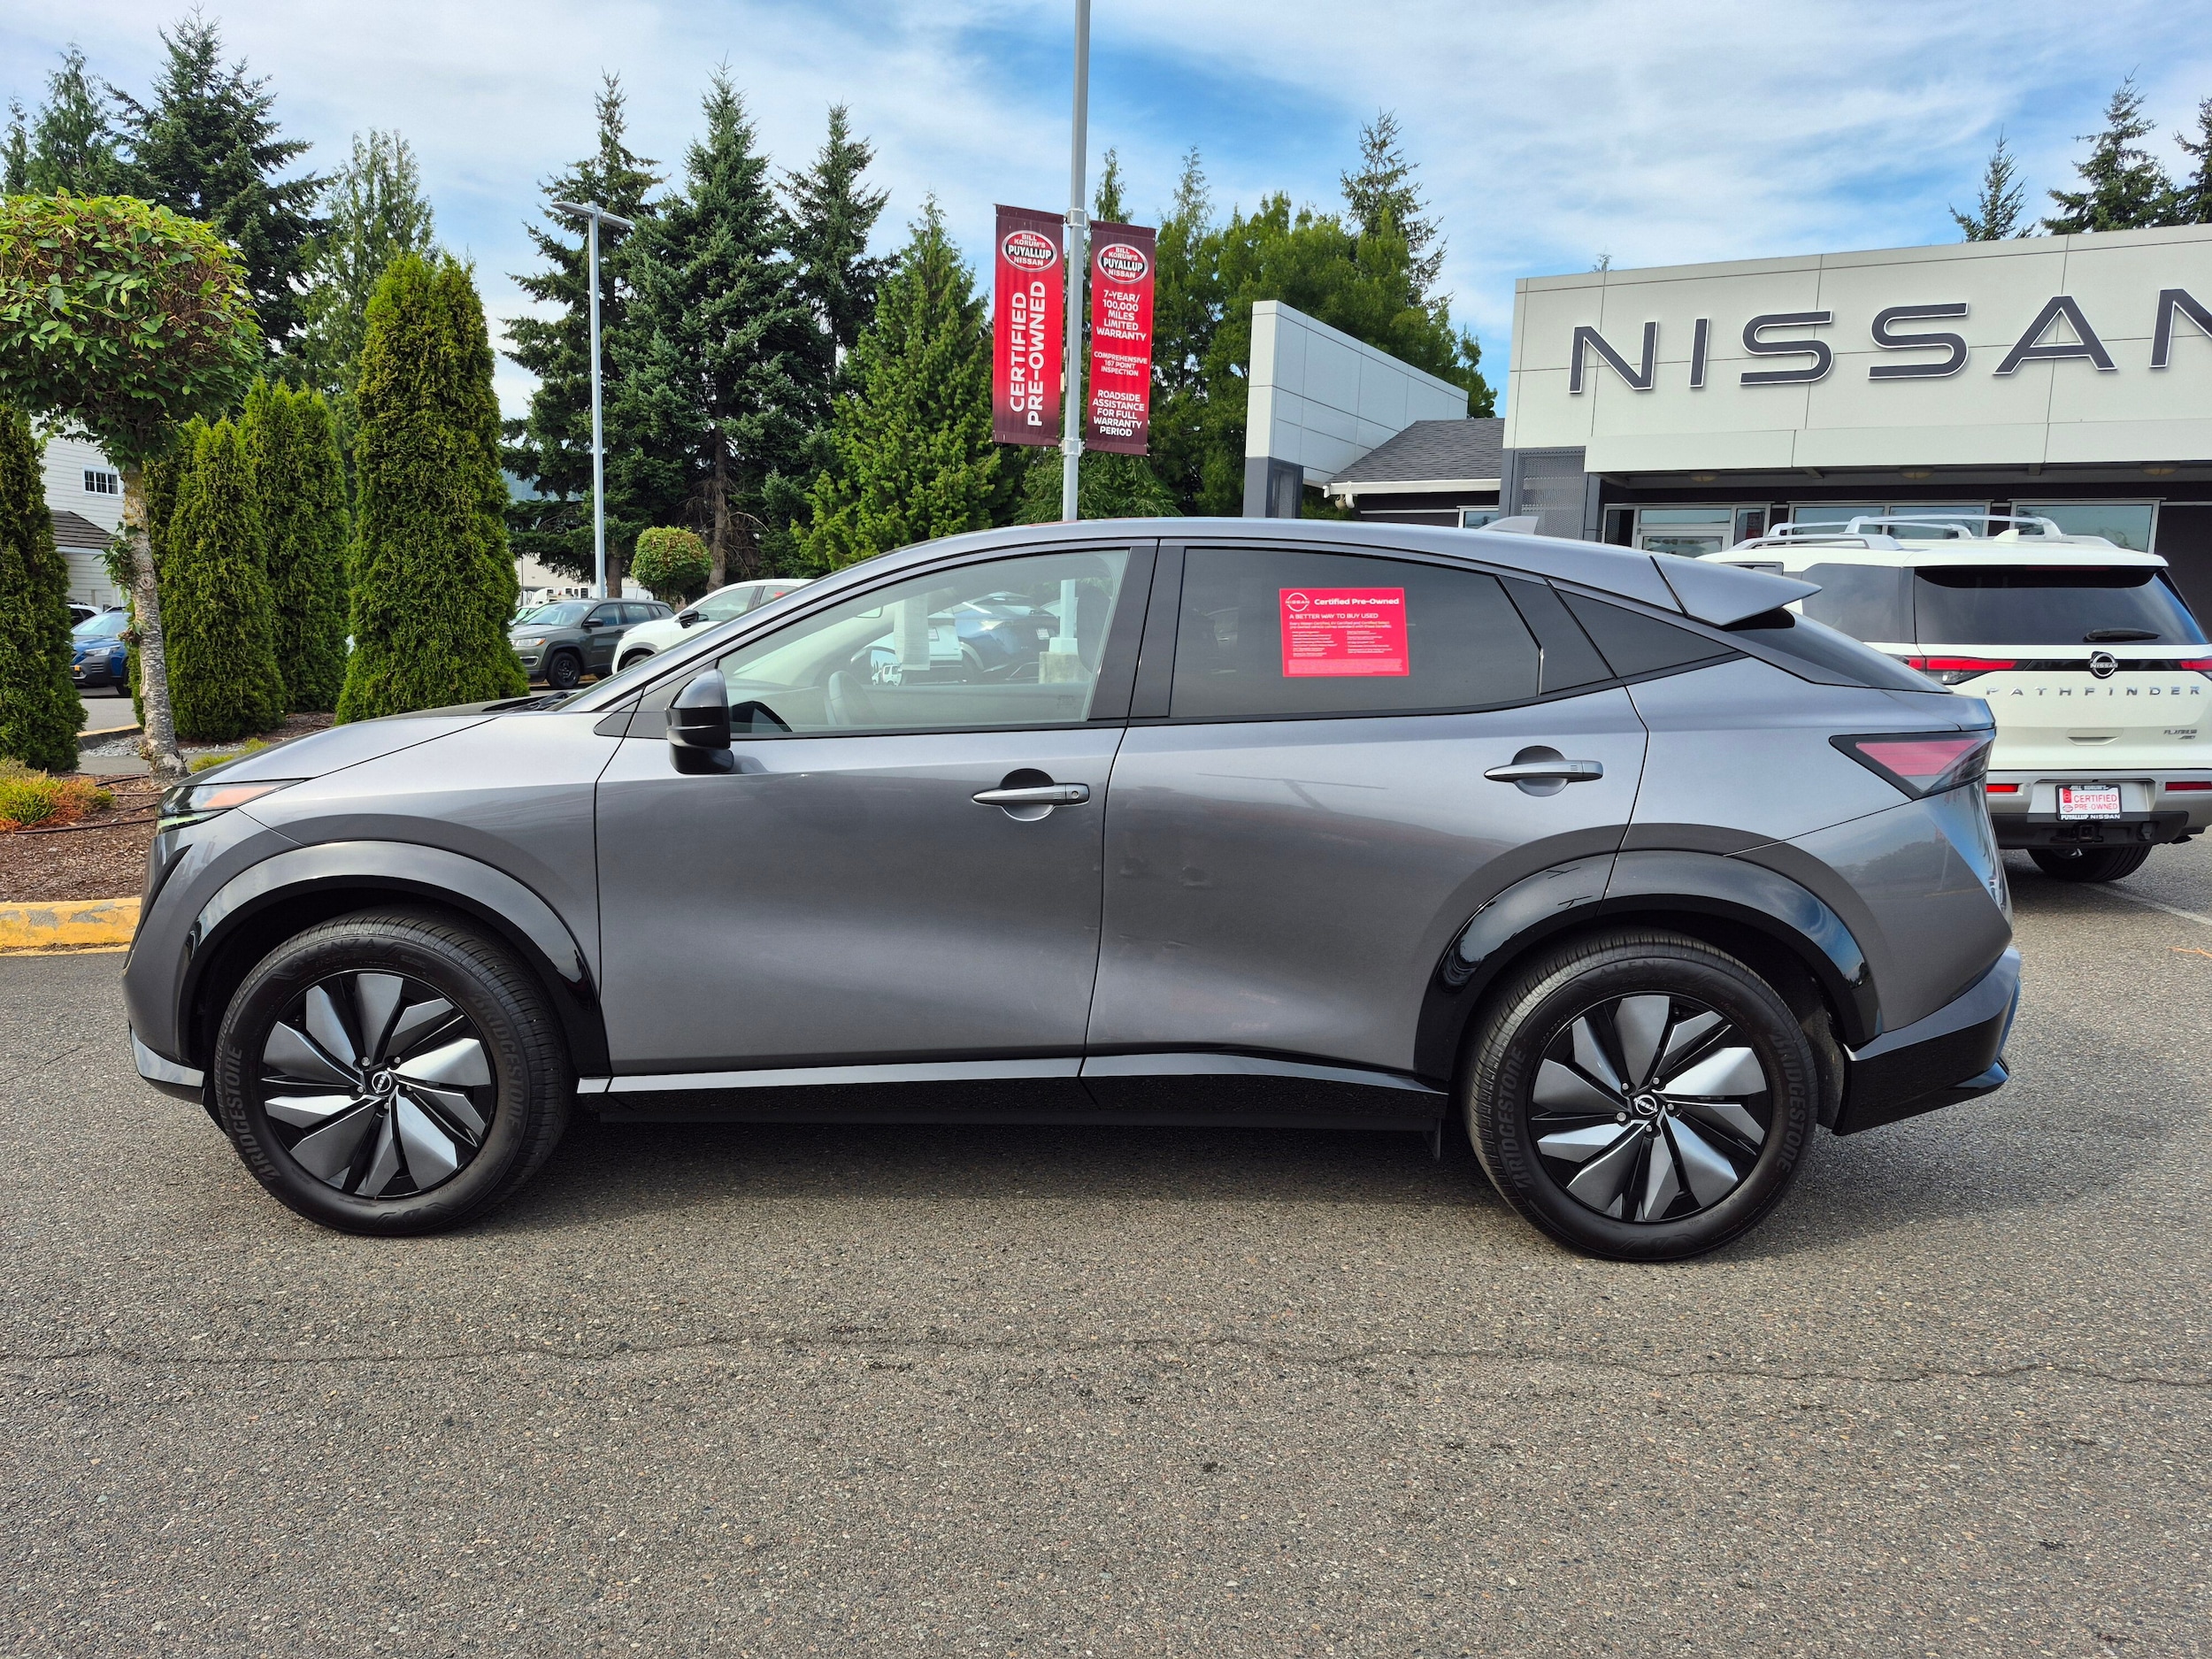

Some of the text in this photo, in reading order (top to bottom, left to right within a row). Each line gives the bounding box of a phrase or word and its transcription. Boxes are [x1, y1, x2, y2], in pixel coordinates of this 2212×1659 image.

[1014, 238, 1046, 249] KORUM'S
[1009, 244, 1052, 260] PUYALLUP
[1108, 251, 1138, 261] KORUM'S
[1013, 256, 1044, 266] NISSAN
[1103, 257, 1144, 273] PUYALLUP
[1108, 268, 1136, 279] NISSAN
[1103, 289, 1141, 303] 7-YEAR/
[1102, 299, 1139, 312] 100,000
[1108, 310, 1135, 321] MILES
[1103, 319, 1139, 331] LIMITED
[1096, 326, 1147, 342] WARRANTY
[1568, 288, 2212, 396] NISSAN
[1010, 292, 1027, 412] CERTIFIED
[1027, 281, 1046, 426] PRE-OWNED
[1094, 350, 1148, 365] COMPREHENSIVE
[1101, 365, 1139, 377] INSPECTION
[1115, 361, 1136, 370] POINT
[1097, 389, 1141, 402] ROADSIDE
[1093, 397, 1145, 411] ASSISTANCE
[1097, 408, 1137, 420] FOR FULL
[1093, 417, 1142, 429] WARRANTY
[1100, 426, 1133, 437] PERIOD
[1985, 686, 2200, 696] PATHFINDER
[2074, 794, 2117, 803] CERTIFIED
[471, 992, 525, 1130] BRIDGESTONE
[1769, 1033, 1807, 1174] BRIDGESTONE
[224, 1043, 282, 1181] BRIDGESTONE
[1497, 1046, 1536, 1189] BRIDGESTONE
